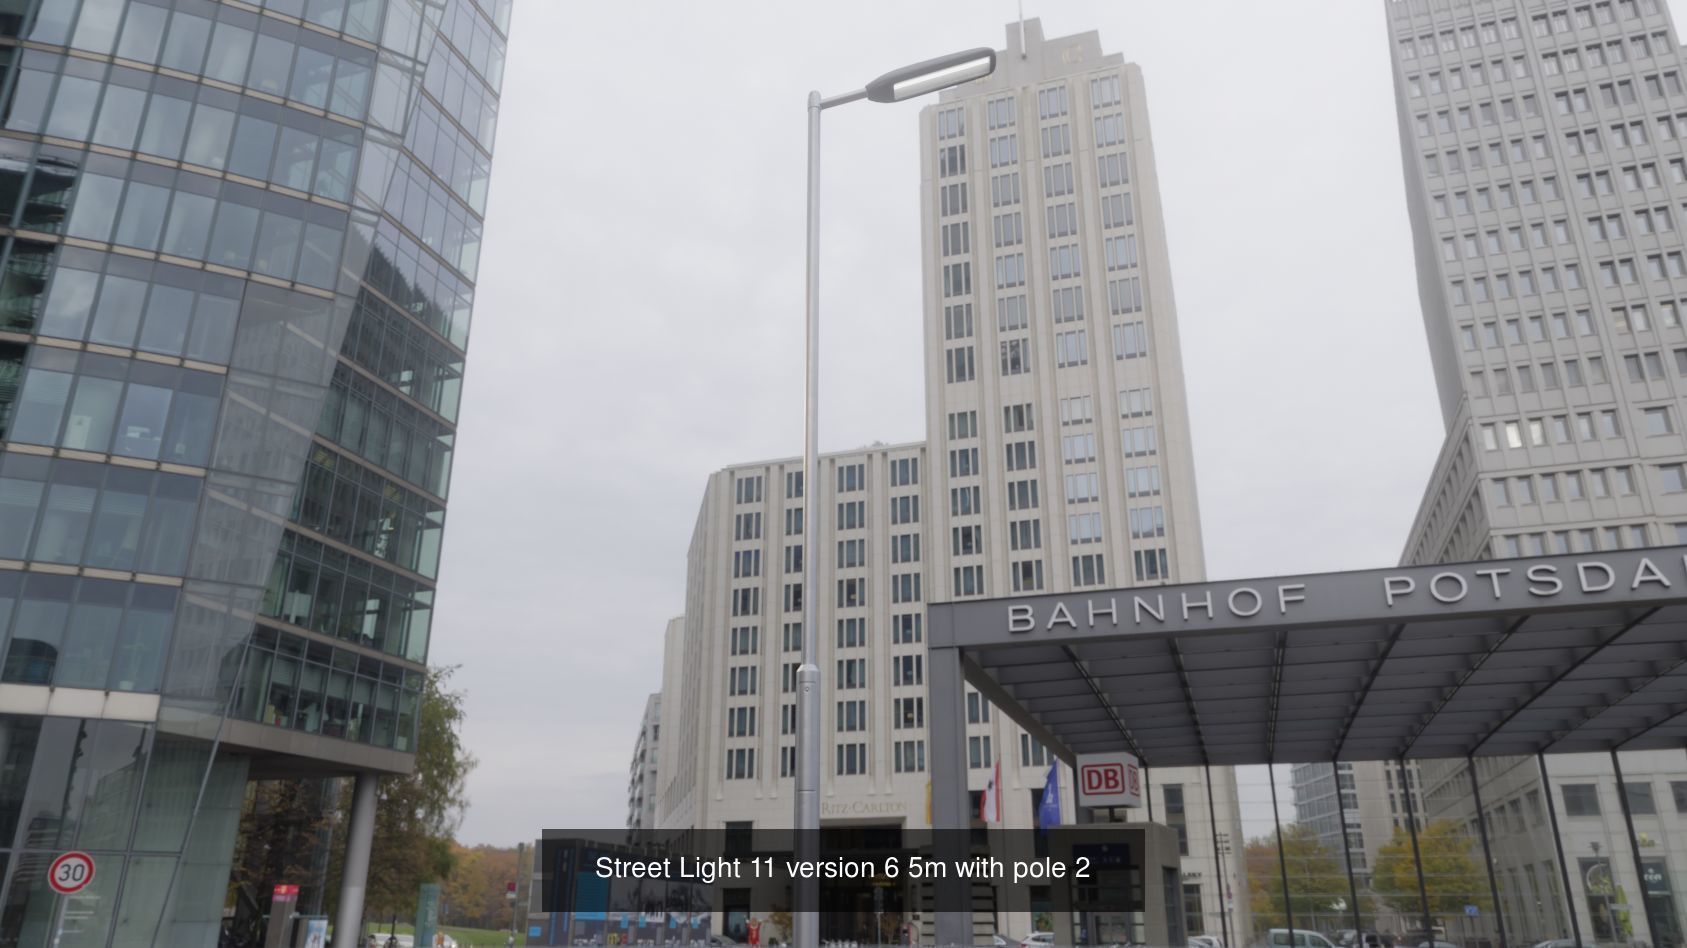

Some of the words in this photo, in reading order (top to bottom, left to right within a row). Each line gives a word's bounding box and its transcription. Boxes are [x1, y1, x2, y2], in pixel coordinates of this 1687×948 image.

[1008, 583, 1306, 632] BAHNHOF
[1384, 555, 1687, 607] POTSDA
[1087, 768, 1119, 790] DB
[58, 863, 85, 882] 30
